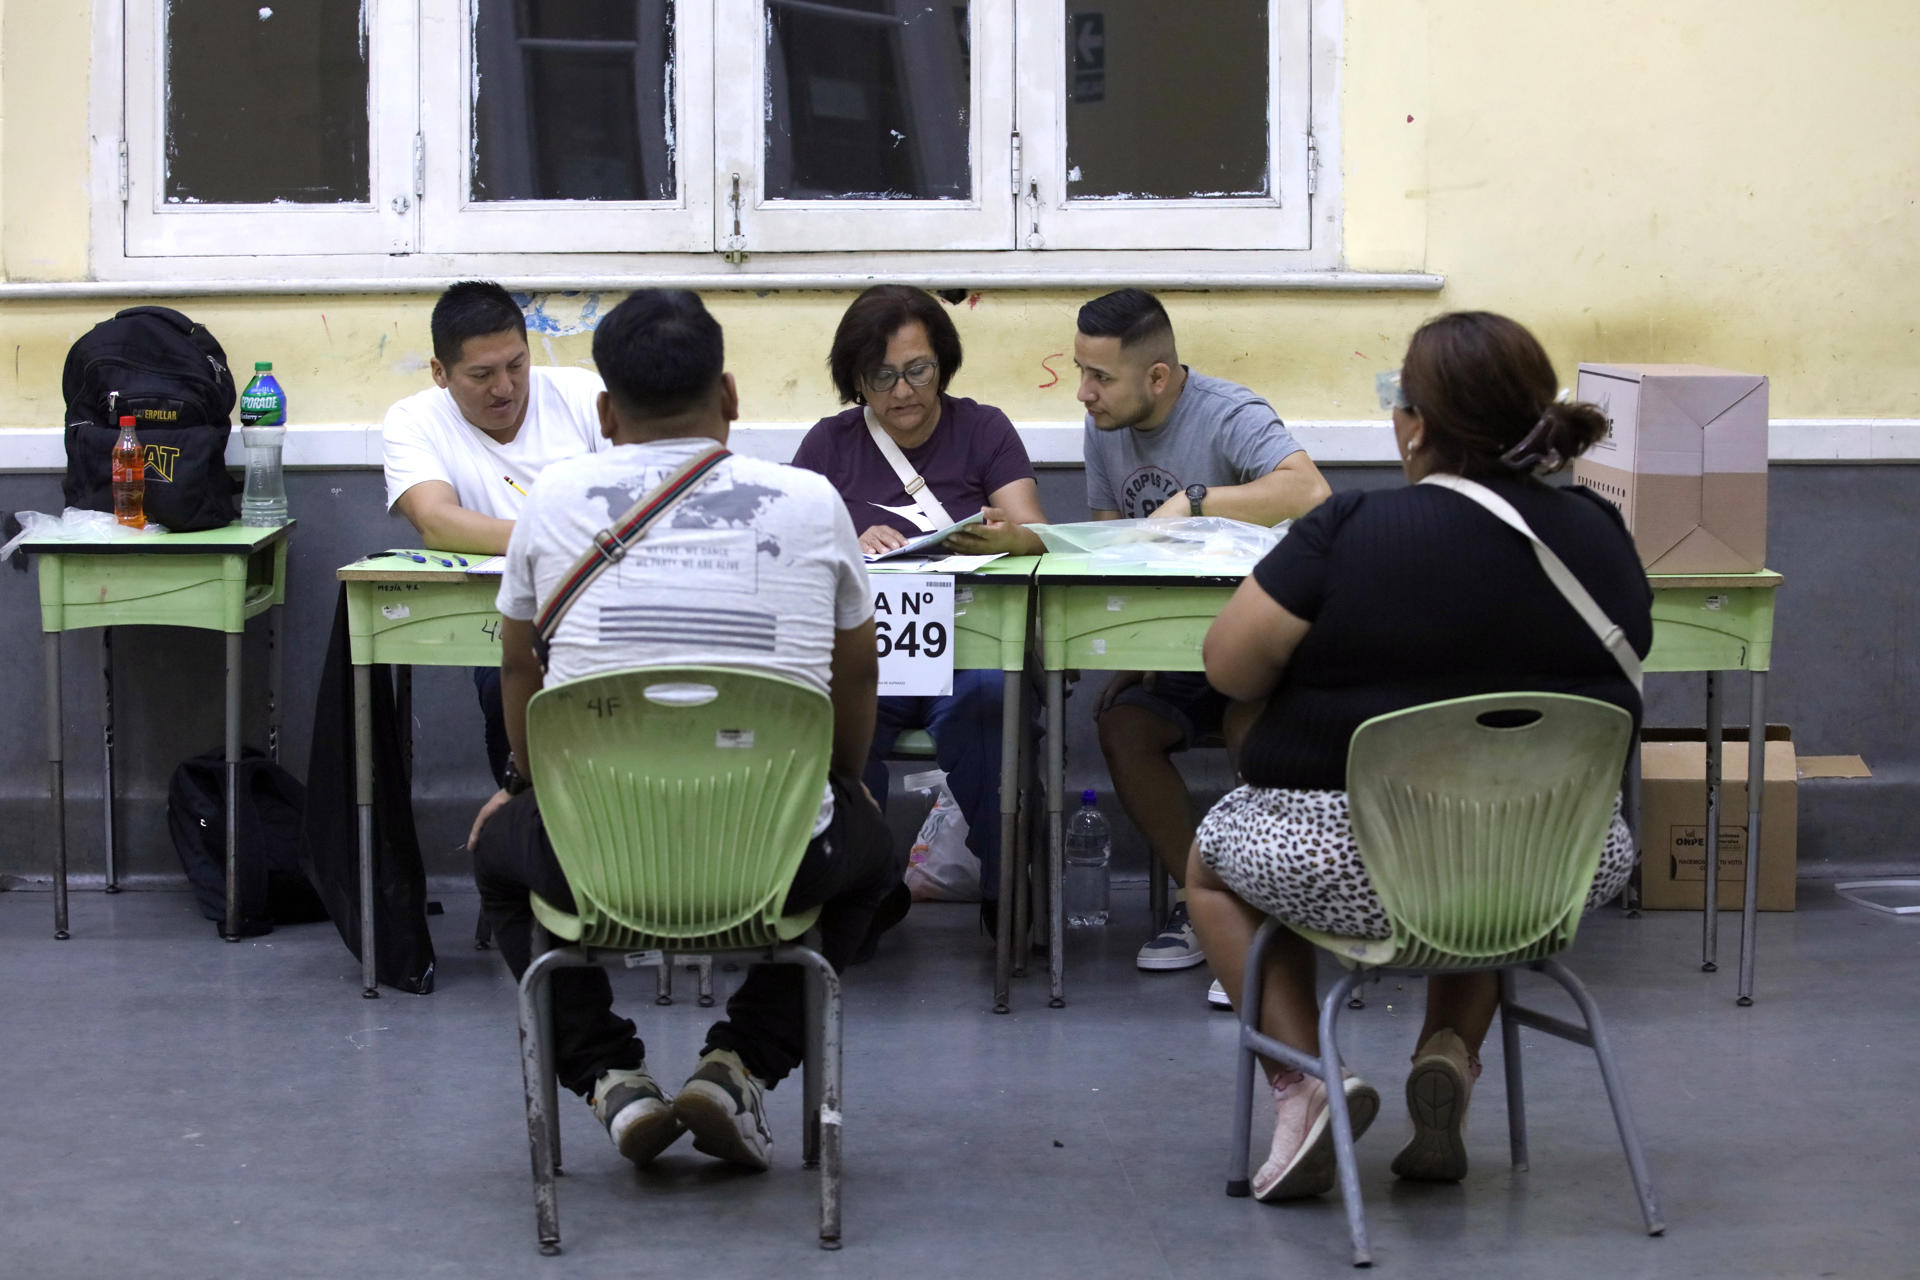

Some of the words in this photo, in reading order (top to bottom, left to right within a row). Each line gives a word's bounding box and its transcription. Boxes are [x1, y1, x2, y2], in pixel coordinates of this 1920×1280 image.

[143, 444, 180, 482] AT
[874, 592, 892, 615] A
[875, 621, 947, 658] 649
[1676, 837, 1705, 847] ONPE
